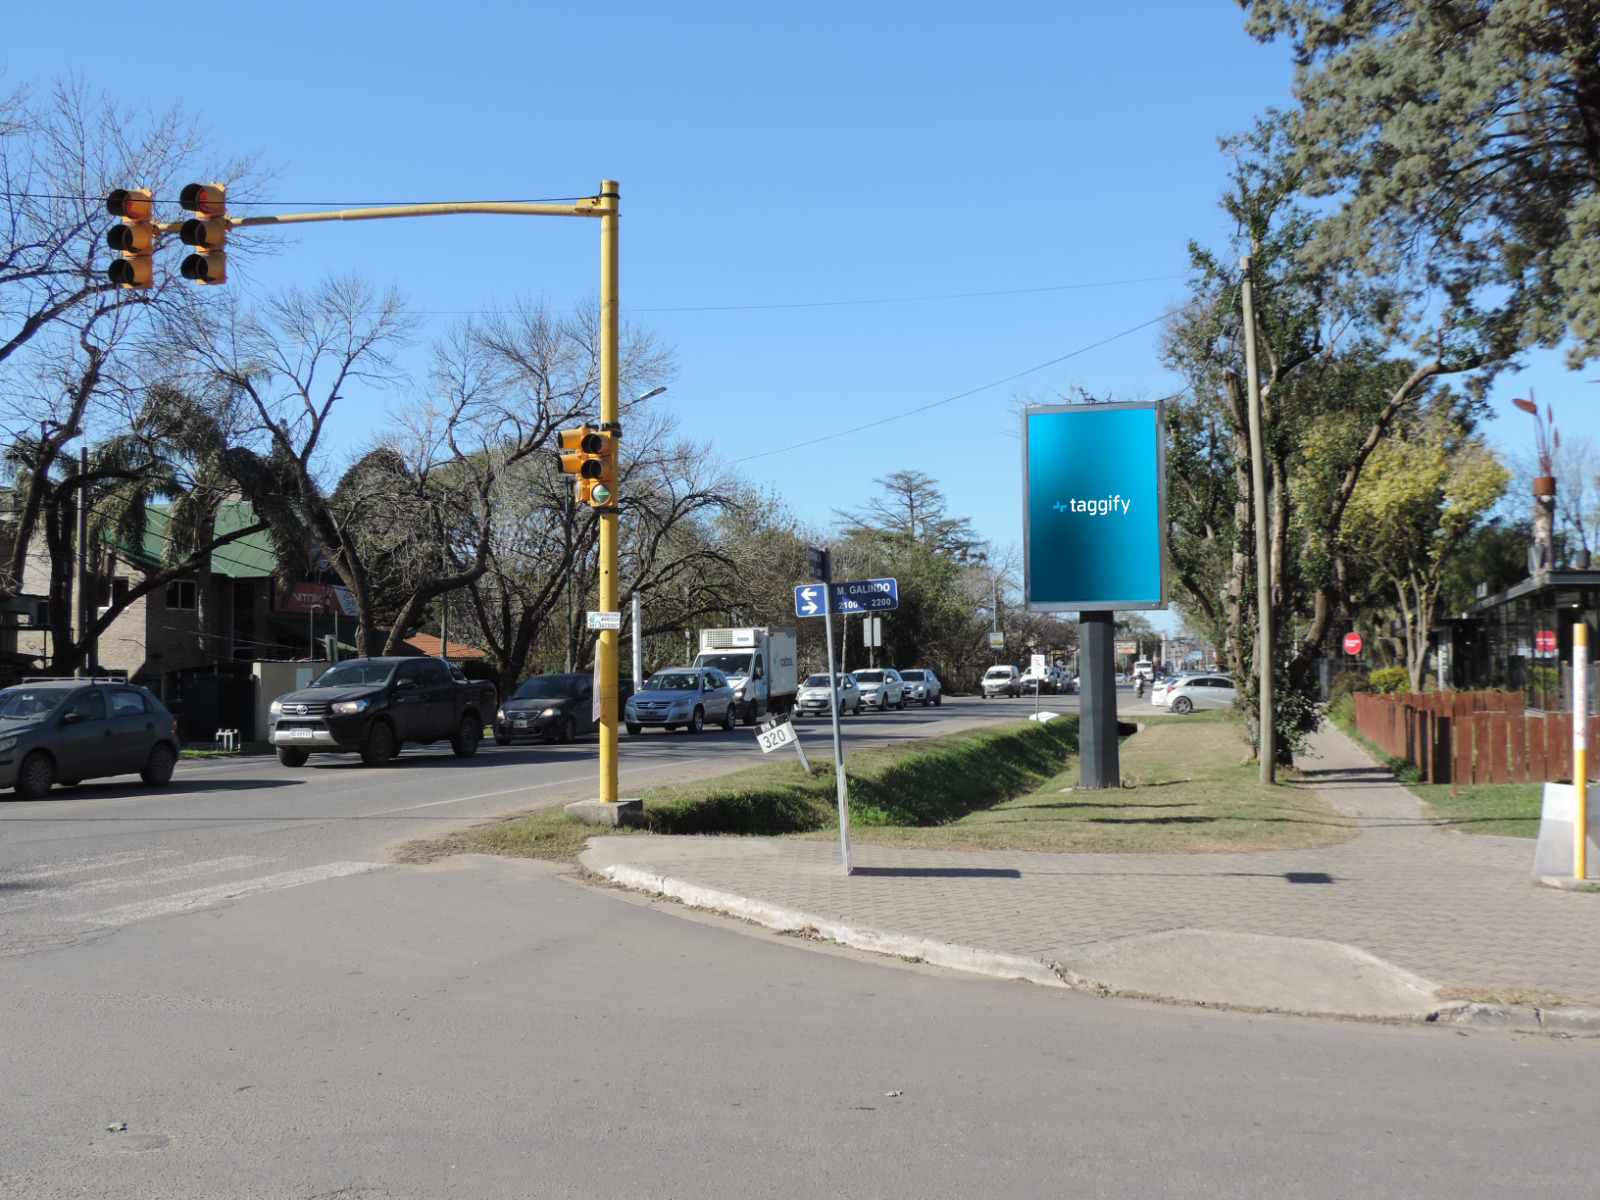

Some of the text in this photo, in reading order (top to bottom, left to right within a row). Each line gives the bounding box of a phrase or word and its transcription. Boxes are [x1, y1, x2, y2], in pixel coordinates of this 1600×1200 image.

[1069, 494, 1131, 516] taggify
[836, 583, 890, 596] M. GALINDO
[838, 600, 858, 610] 2100
[871, 597, 891, 607] 2200
[760, 719, 777, 733] RN 9
[763, 729, 786, 749] 320
